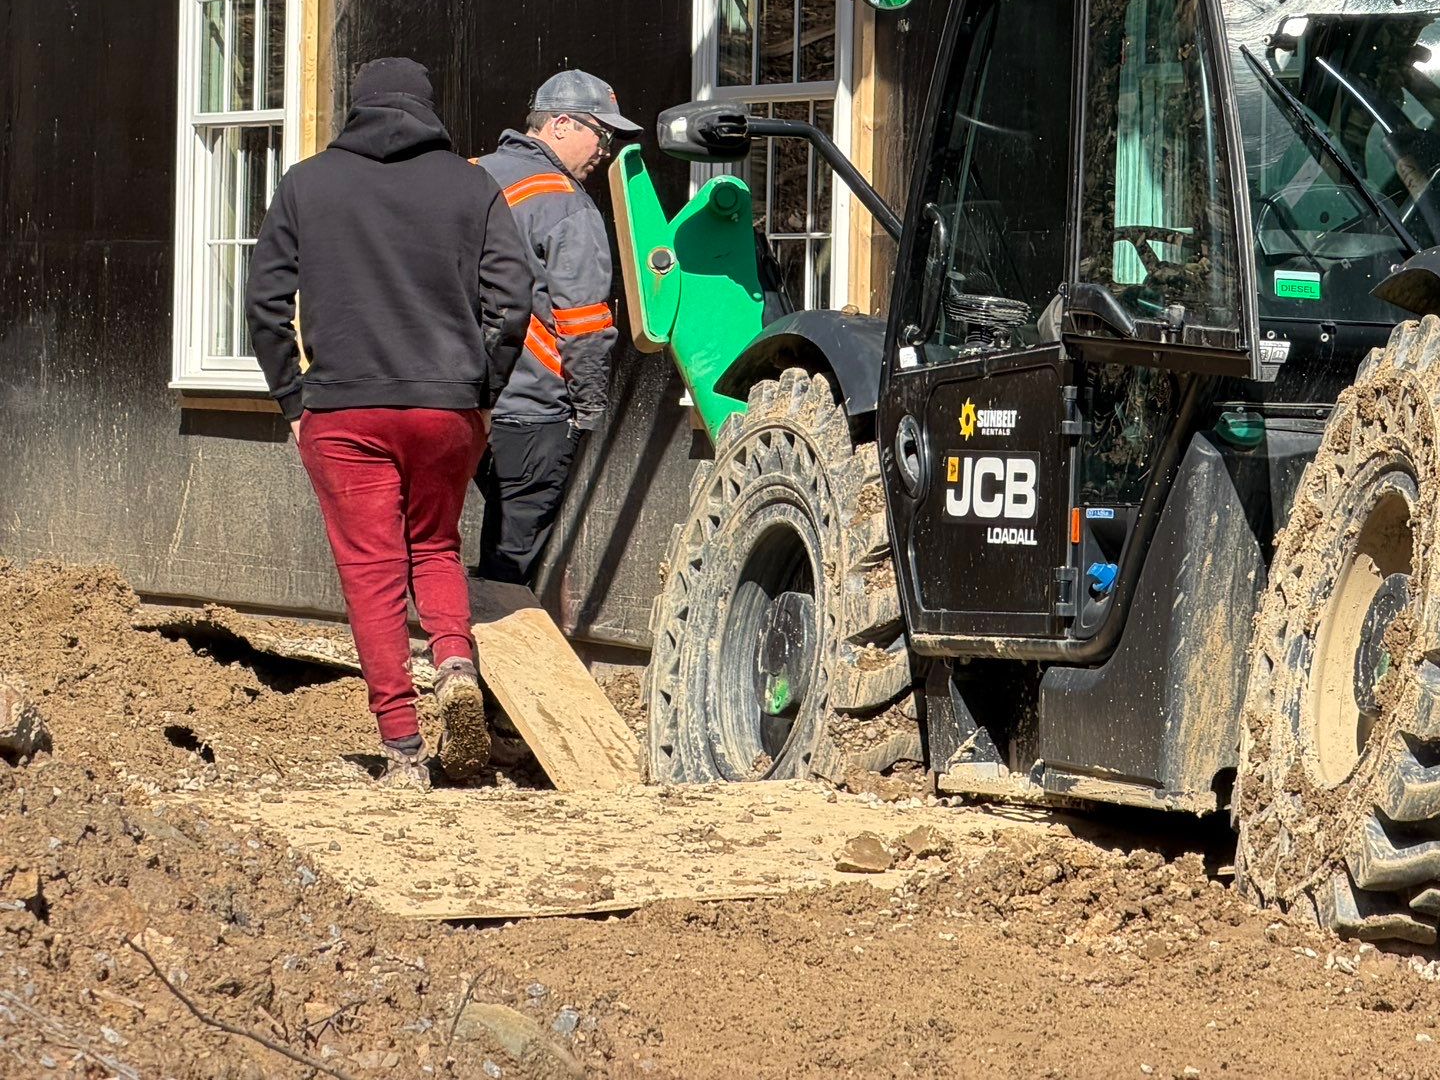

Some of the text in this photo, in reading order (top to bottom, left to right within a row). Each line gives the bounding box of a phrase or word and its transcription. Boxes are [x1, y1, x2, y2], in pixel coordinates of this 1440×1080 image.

[1280, 283, 1316, 295] DIESEL
[976, 409, 1018, 429] SUNBELT
[981, 428, 1012, 436] RENTALS
[945, 456, 1037, 520] JCB
[986, 527, 1039, 546] LOADALL
